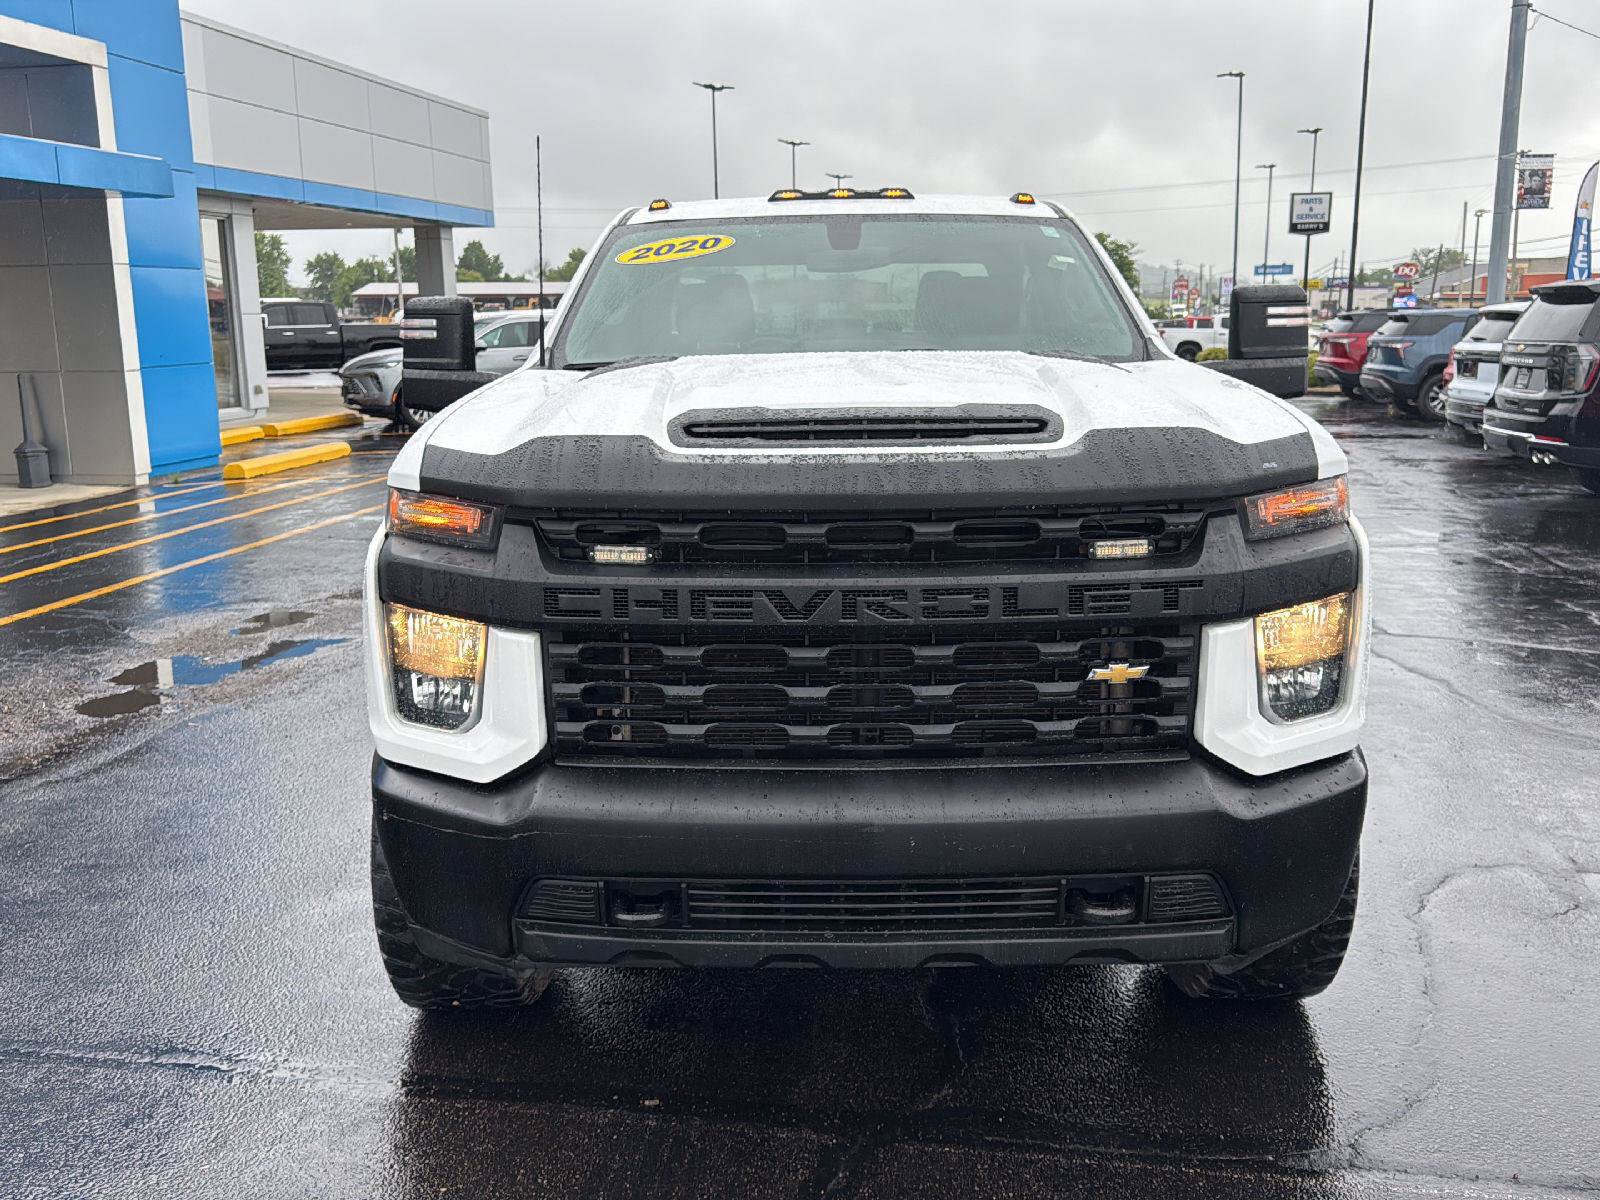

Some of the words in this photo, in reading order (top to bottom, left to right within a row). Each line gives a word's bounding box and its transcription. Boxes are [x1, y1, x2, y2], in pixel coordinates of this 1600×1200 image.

[1296, 213, 1326, 221] SERVICE
[627, 237, 721, 262] 2020
[1397, 266, 1417, 277] DQ
[543, 579, 1204, 623] CHEVROLET
